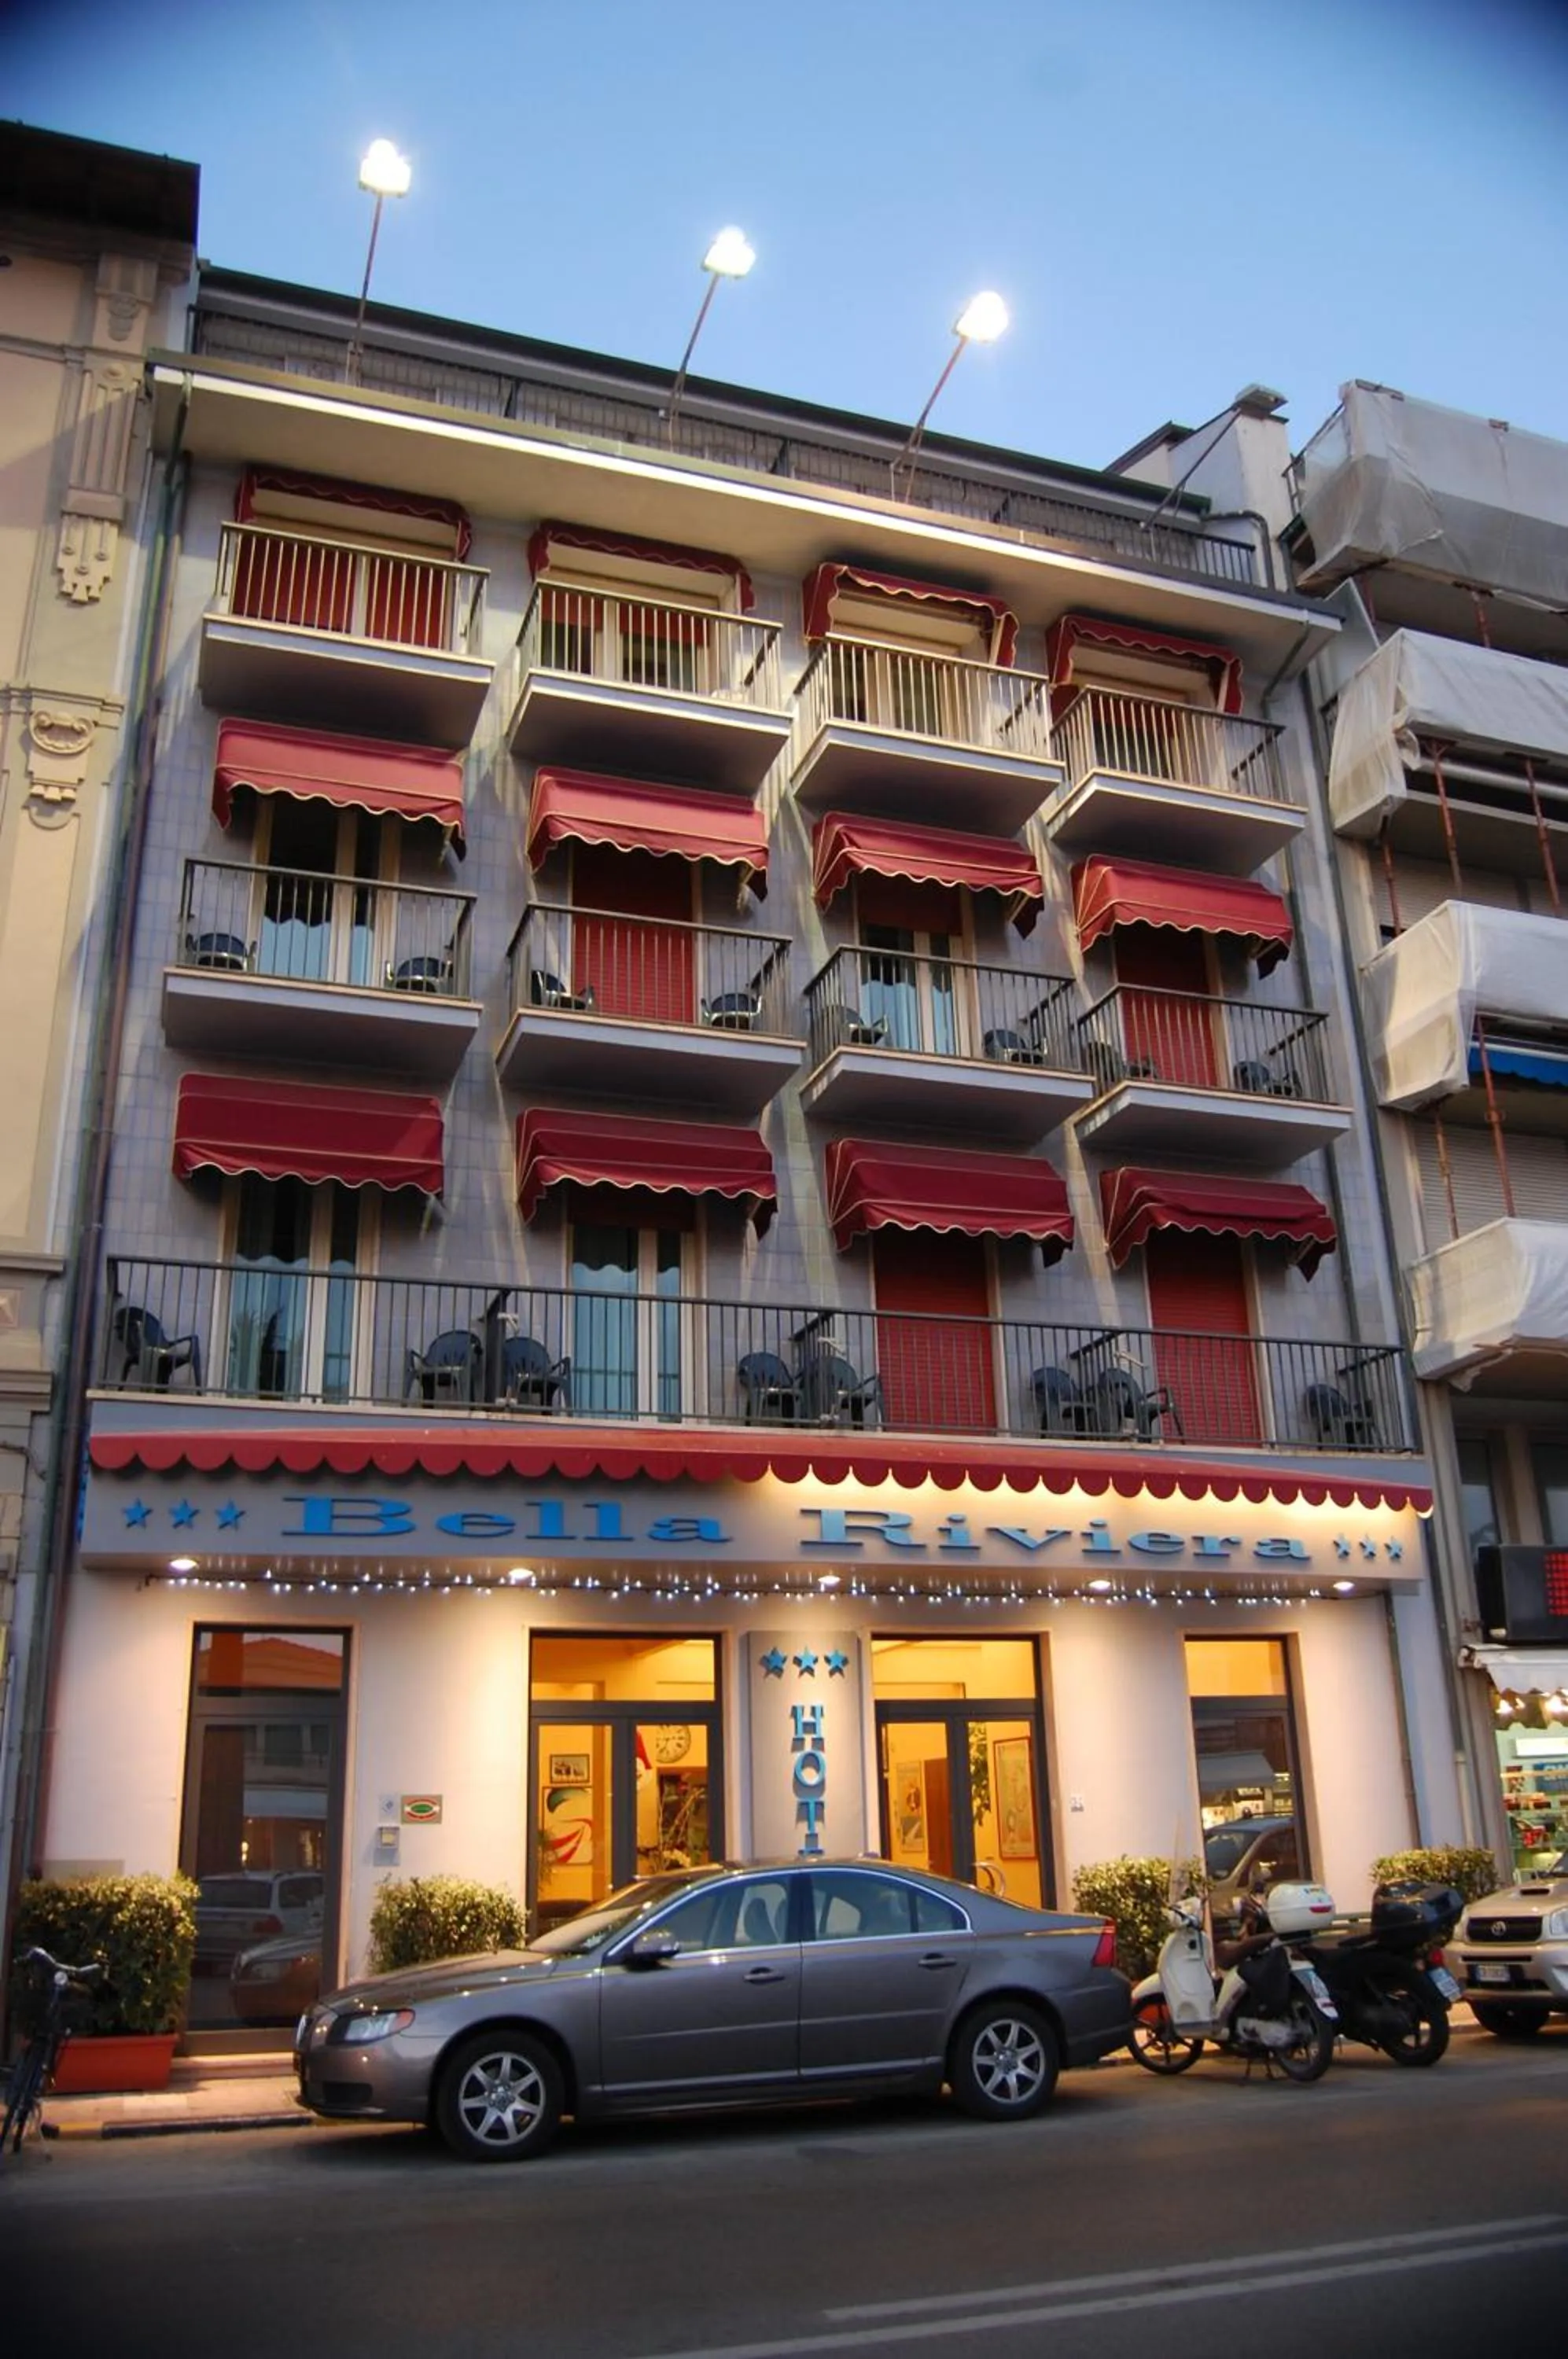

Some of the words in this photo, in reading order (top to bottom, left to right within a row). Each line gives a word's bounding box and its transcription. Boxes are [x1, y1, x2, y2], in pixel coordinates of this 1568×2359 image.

[282, 1497, 733, 1543] Bella
[800, 1508, 1312, 1561] Riviera
[790, 1704, 826, 1855] HOT
